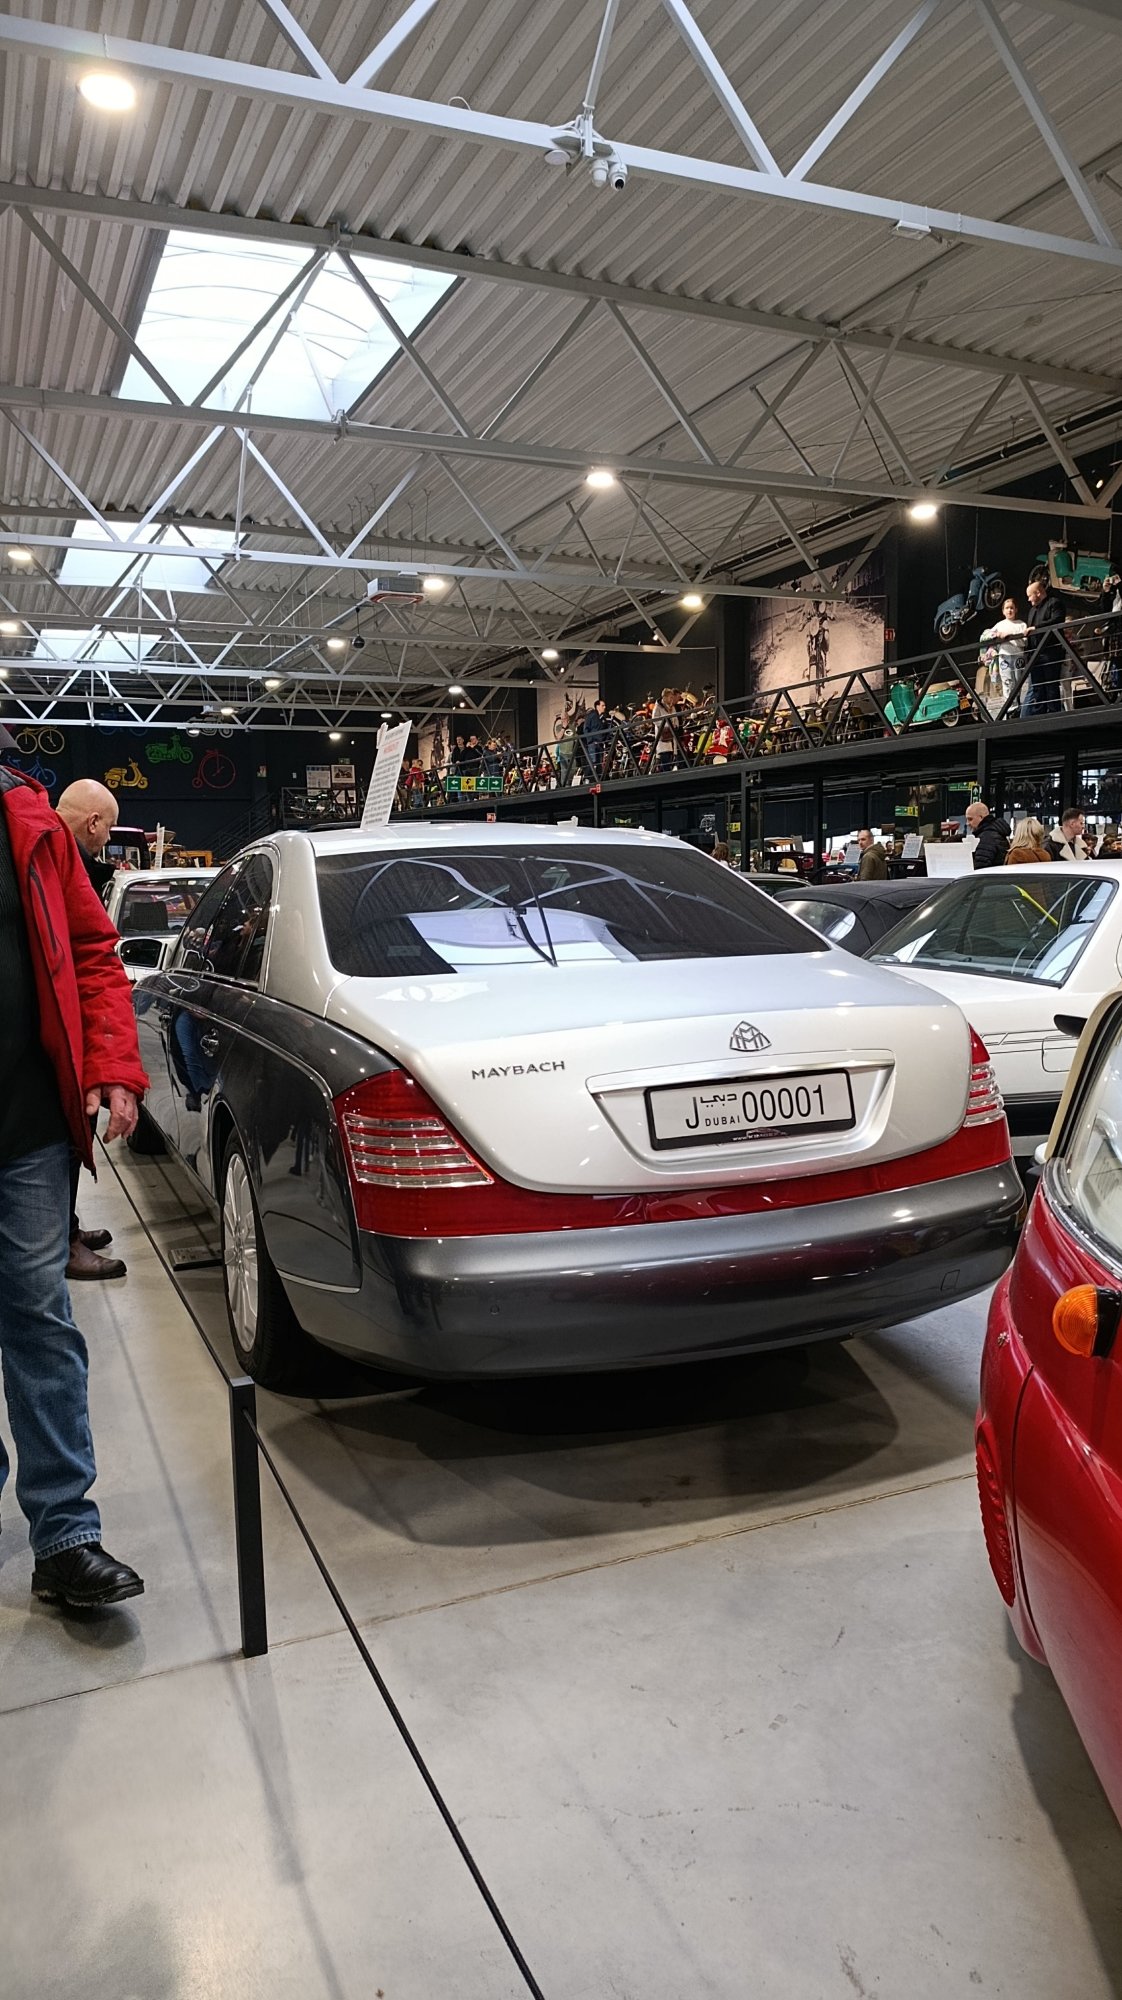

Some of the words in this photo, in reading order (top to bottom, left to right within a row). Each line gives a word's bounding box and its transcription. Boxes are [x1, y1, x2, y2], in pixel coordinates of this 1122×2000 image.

[471, 1060, 565, 1080] MAYBACH
[685, 1096, 700, 1129] J
[742, 1084, 825, 1123] 00001
[700, 1093, 738, 1108] دبي
[705, 1116, 740, 1127] DUBAI
